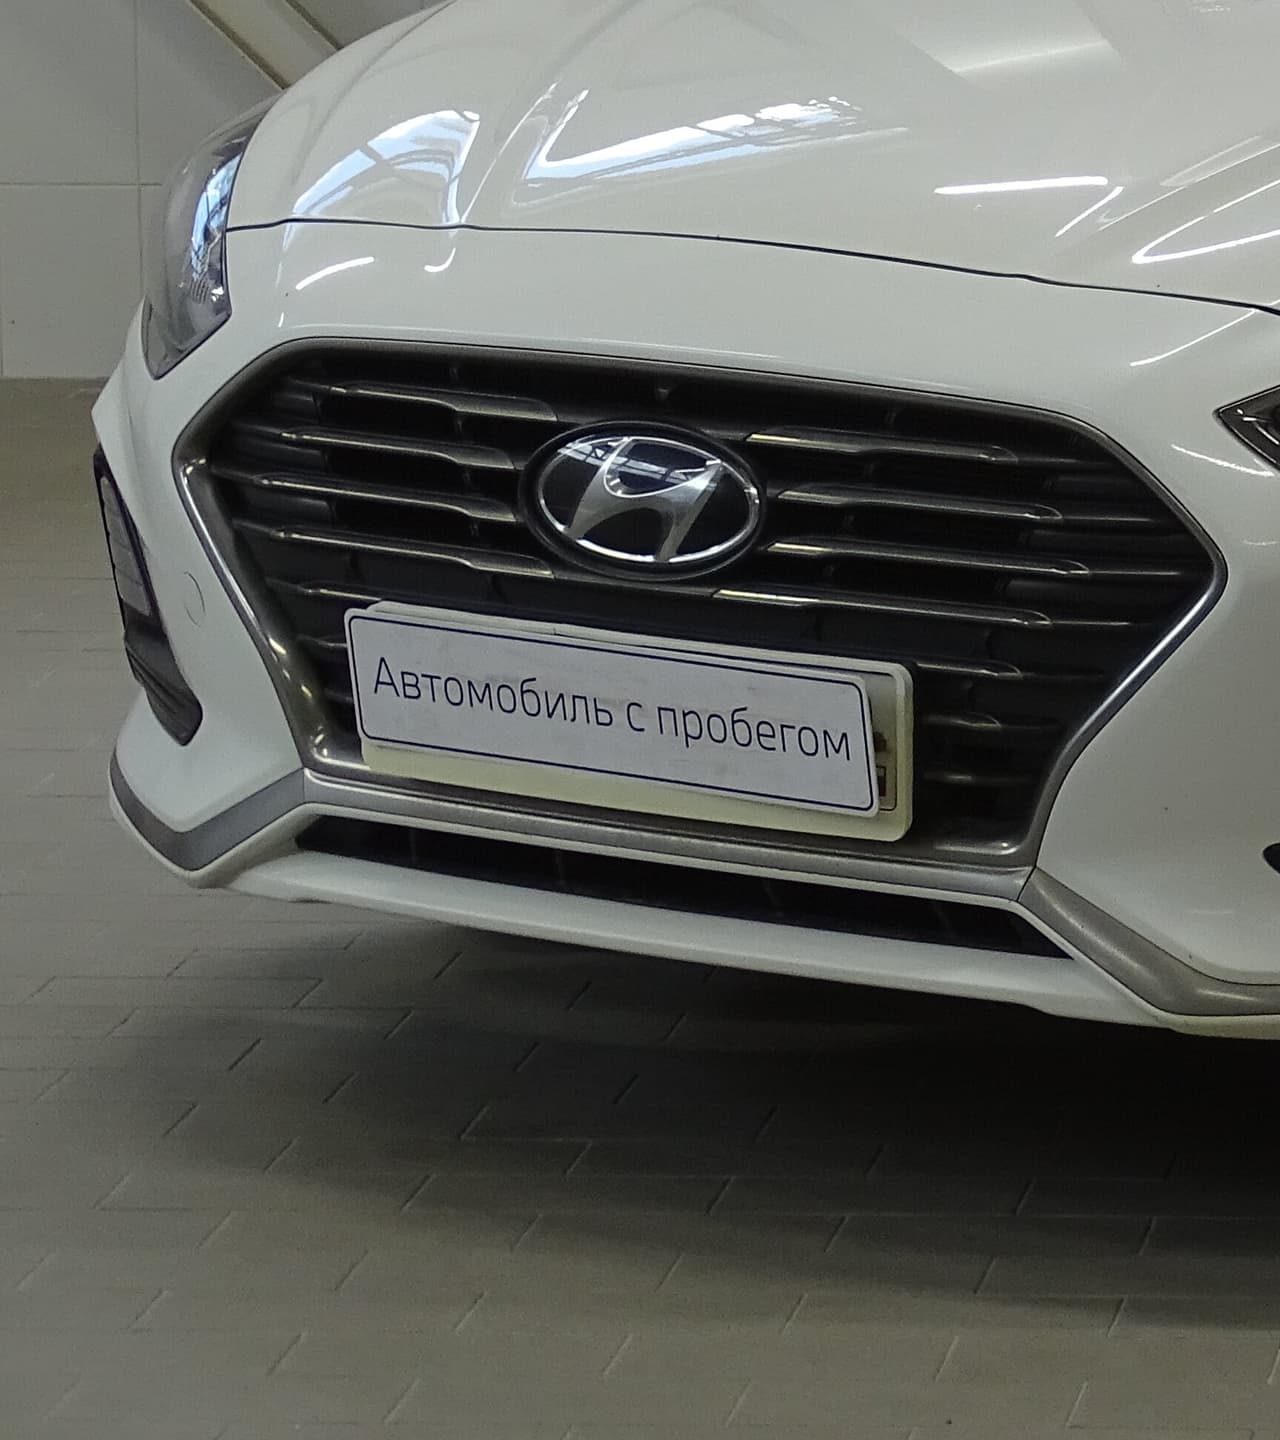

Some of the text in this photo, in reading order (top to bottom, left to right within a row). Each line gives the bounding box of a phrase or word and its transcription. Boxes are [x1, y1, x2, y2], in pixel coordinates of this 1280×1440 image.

[373, 656, 853, 762] Автомобиль с пробегом
